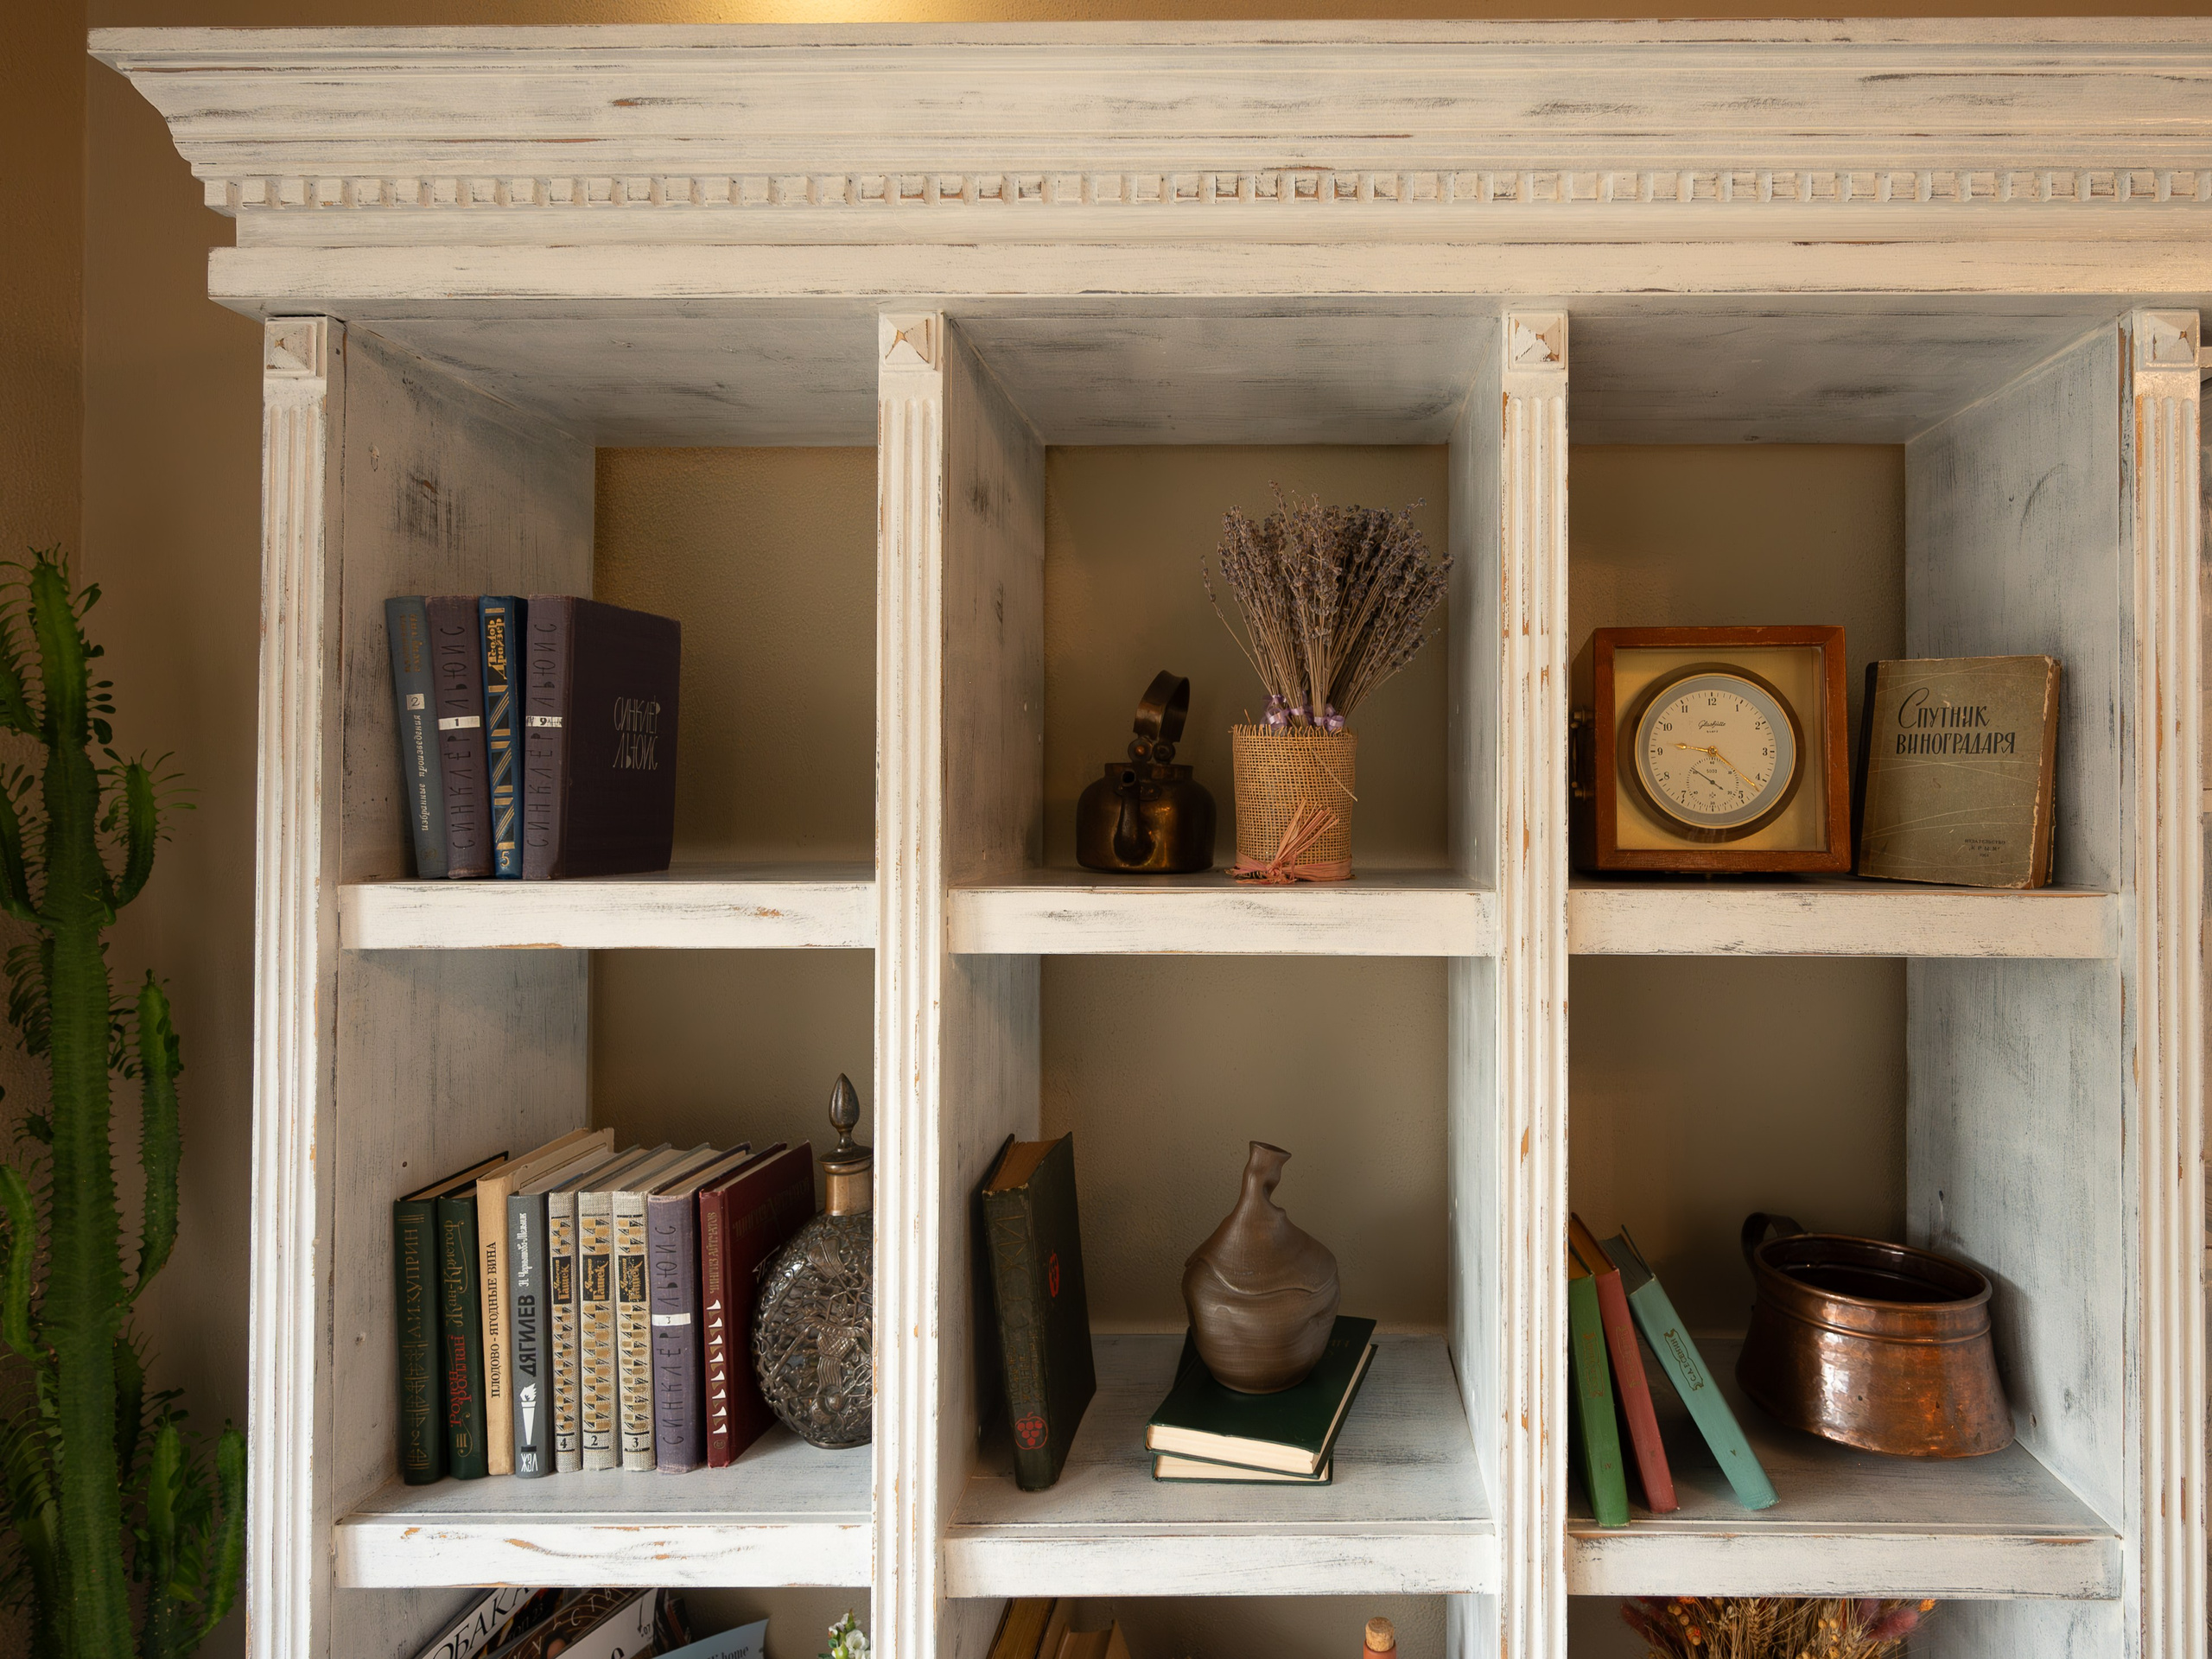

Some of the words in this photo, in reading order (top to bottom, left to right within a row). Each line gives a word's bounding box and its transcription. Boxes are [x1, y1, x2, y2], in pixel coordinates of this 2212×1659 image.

[440, 626, 469, 709] ЛЬЮИС
[532, 623, 556, 708] ЛЬЮИС
[410, 696, 421, 708] 2
[539, 717, 548, 726] 9
[1662, 722, 1673, 731] 10
[414, 714, 429, 779] произведения
[613, 734, 658, 771] ЛЬЮИС
[1657, 747, 1663, 756] 9
[1762, 747, 1768, 756] 3
[1896, 731, 2017, 754] ВИНОГРАДАРЯ
[1663, 772, 1670, 780] 8
[1681, 790, 1687, 798] 7
[1738, 790, 1744, 799] 5
[420, 782, 429, 832] избранные
[499, 850, 511, 867] 5
[486, 1242, 497, 1274] ВИНА
[655, 1225, 679, 1307] ЛЬЮИС
[557, 1263, 570, 1300] Гашек
[593, 1261, 608, 1301] Гашек
[488, 1276, 499, 1336] ЯГОДНЫЕ
[518, 1294, 537, 1377] ДЯГИЛЕВ
[490, 1344, 500, 1398] ПЛОДОВО
[560, 1437, 568, 1449] 4
[590, 1434, 598, 1447] 2
[632, 1436, 639, 1448] 3
[520, 1453, 538, 1472] ЖЗЛ
